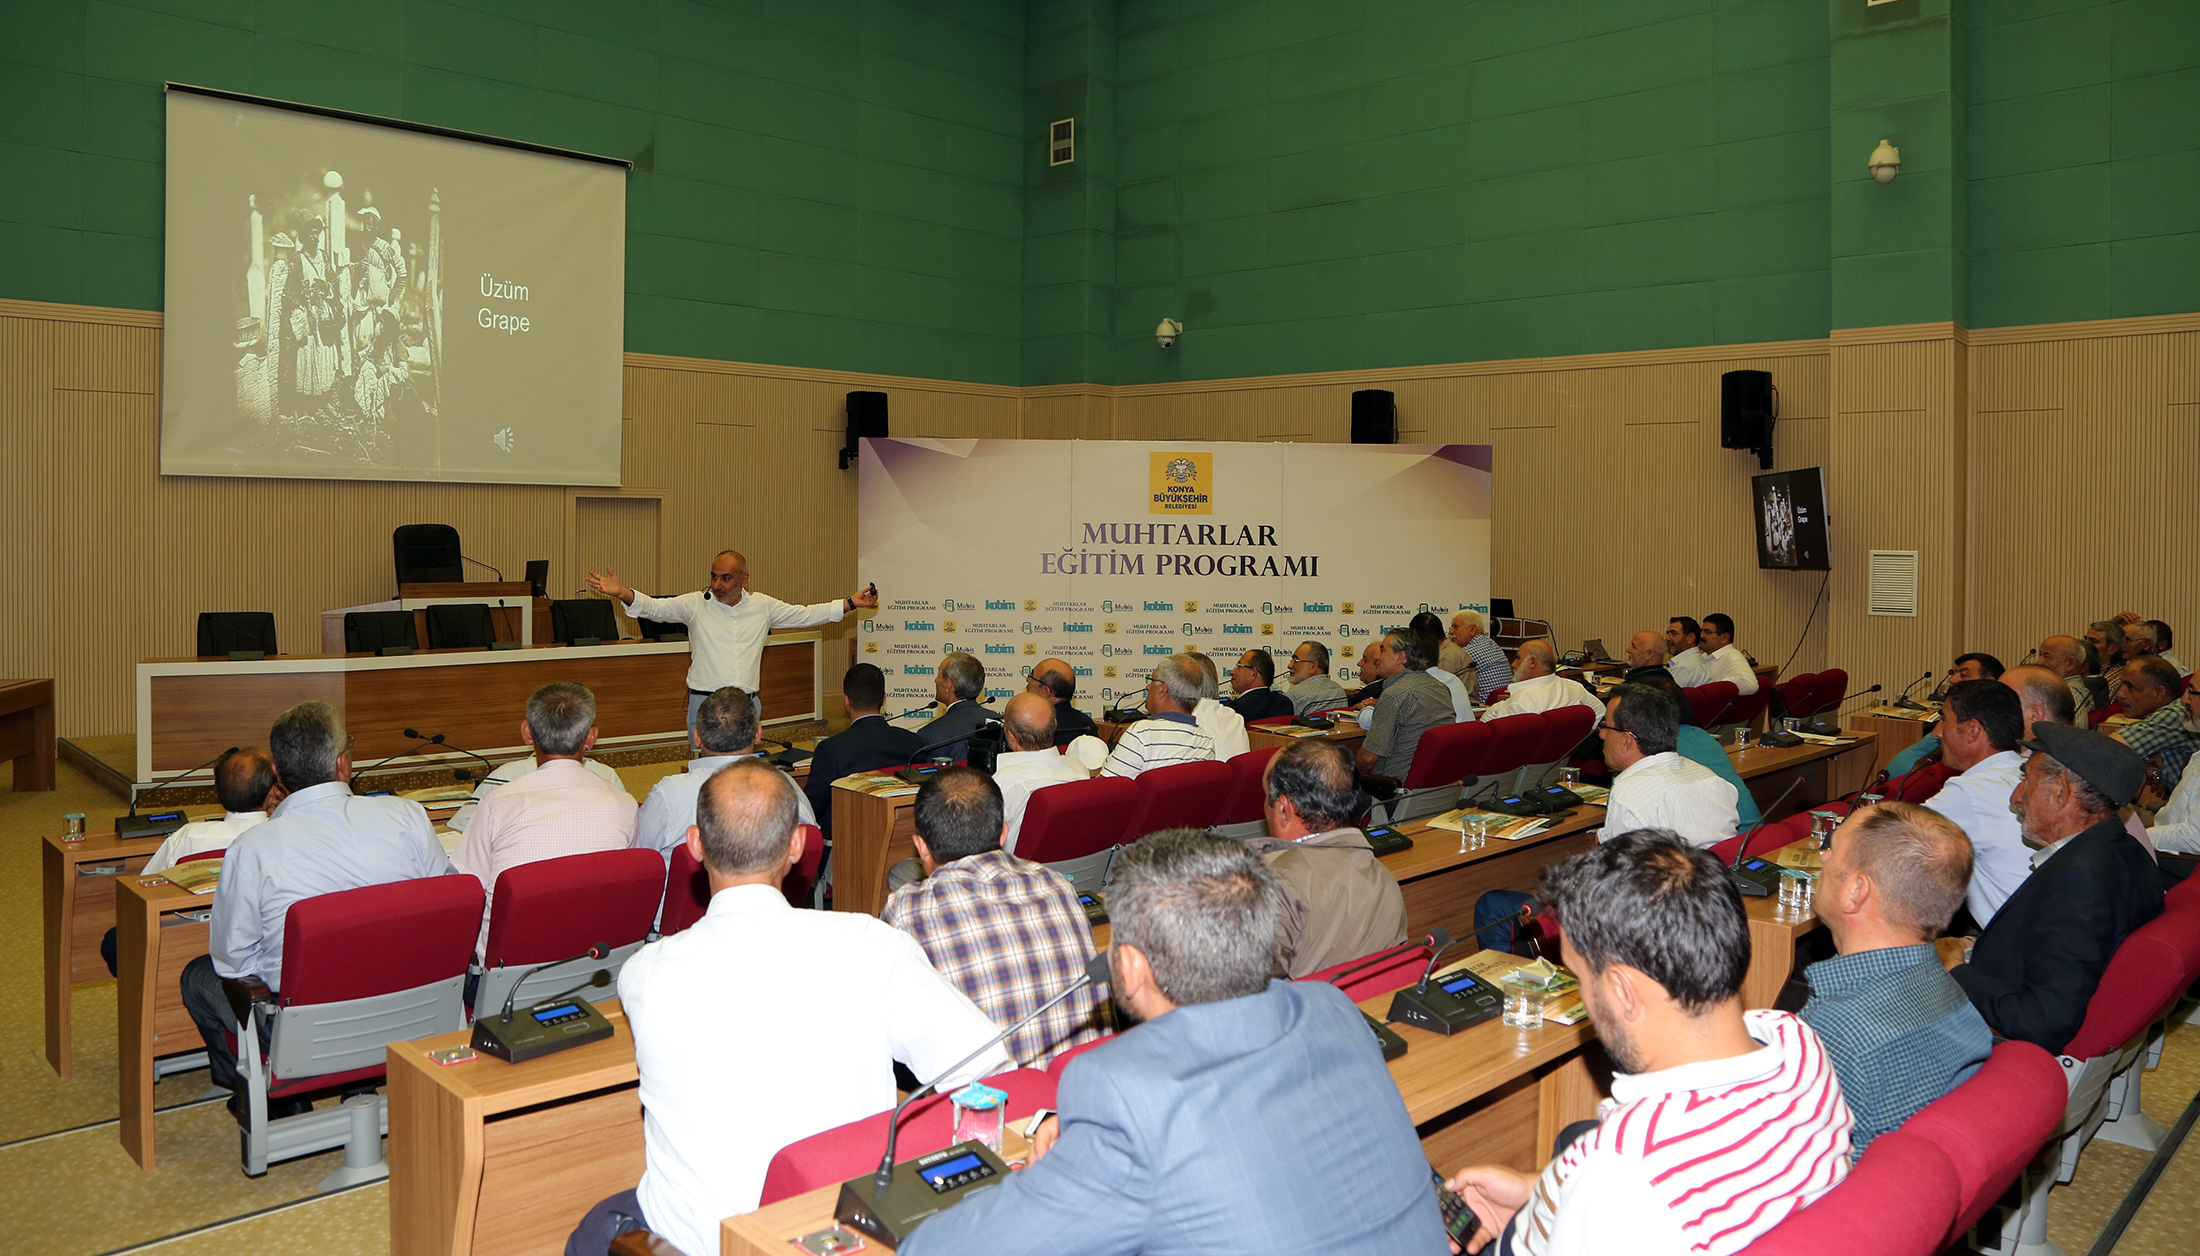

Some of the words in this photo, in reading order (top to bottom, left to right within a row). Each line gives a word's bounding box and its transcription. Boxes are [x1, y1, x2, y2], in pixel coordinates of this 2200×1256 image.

[480, 273, 529, 301] Üzüm
[478, 308, 530, 335] Grape
[1153, 493, 1208, 504] BÜYÜKŞEHİR
[1082, 522, 1278, 546] MUHTARLAR
[1041, 547, 1145, 575] EĞİTİM
[1155, 554, 1319, 577] PROGRAMI
